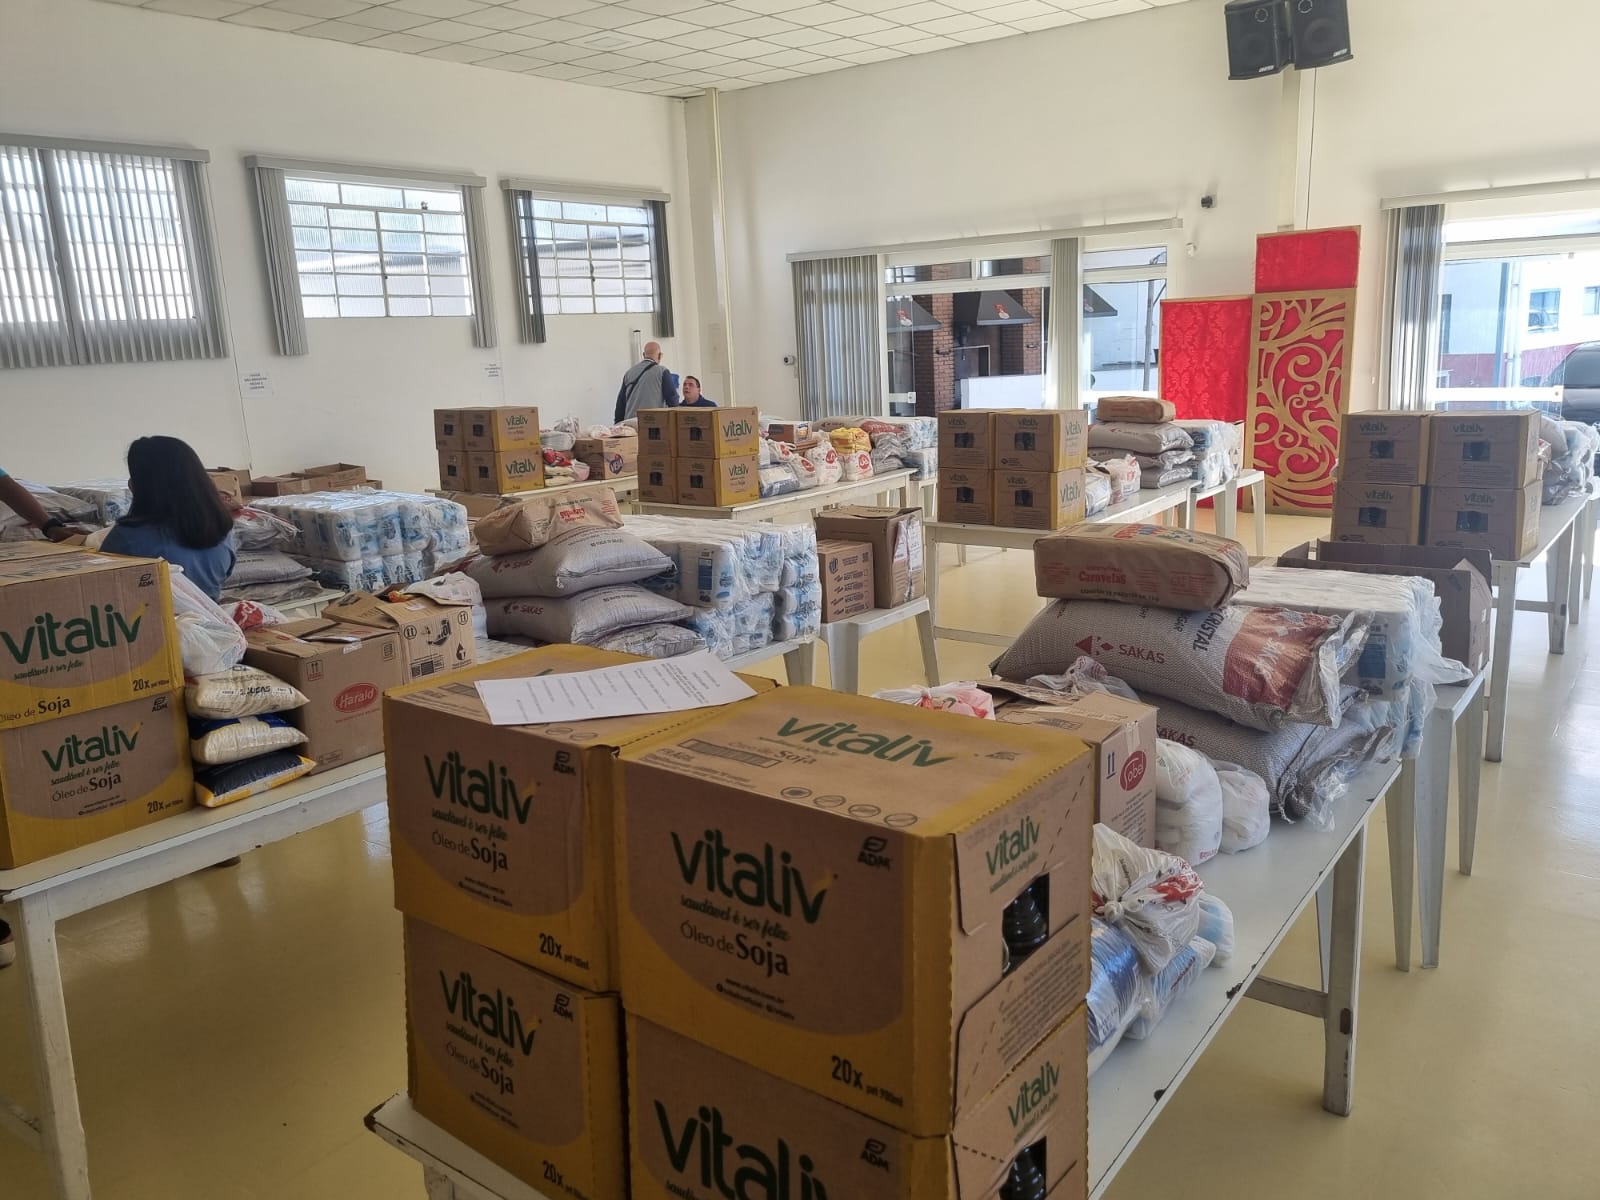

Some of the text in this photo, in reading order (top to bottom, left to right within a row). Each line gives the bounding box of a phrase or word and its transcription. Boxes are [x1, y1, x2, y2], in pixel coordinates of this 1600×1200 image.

[506, 415, 529, 427] vitaliv
[720, 419, 753, 438] vitaliv
[505, 460, 537, 476] vitaliv
[729, 463, 750, 477] vitaliv
[0, 602, 145, 665] vitaliv
[1193, 609, 1226, 653] CRISTAL
[1118, 643, 1166, 665] SAKAS
[132, 678, 151, 692] 20x
[340, 687, 374, 708] Harald
[24, 706, 36, 717] de
[37, 696, 71, 715] Soja
[41, 721, 142, 773] vitaliv
[777, 716, 960, 769] vitaliv
[52, 771, 122, 802] Óleo de Soja
[423, 749, 537, 825] vitaliv
[147, 800, 164, 814] 20x
[431, 829, 509, 873] Óleo de Soja
[857, 851, 892, 871] ADM
[985, 815, 1041, 876] vitaliv
[670, 828, 832, 925] vitaliv
[539, 931, 563, 960] 20x
[680, 919, 791, 978] Óleo de Soja
[438, 969, 537, 1057] vitaliv
[551, 1004, 575, 1023] ADM
[446, 1040, 515, 1096] Óleo de Soja
[832, 1054, 865, 1091] 20x
[1007, 1060, 1061, 1129] vitaliv
[653, 1098, 829, 1200] vitali
[859, 1149, 891, 1174] ADM
[542, 1159, 565, 1189] 20x
